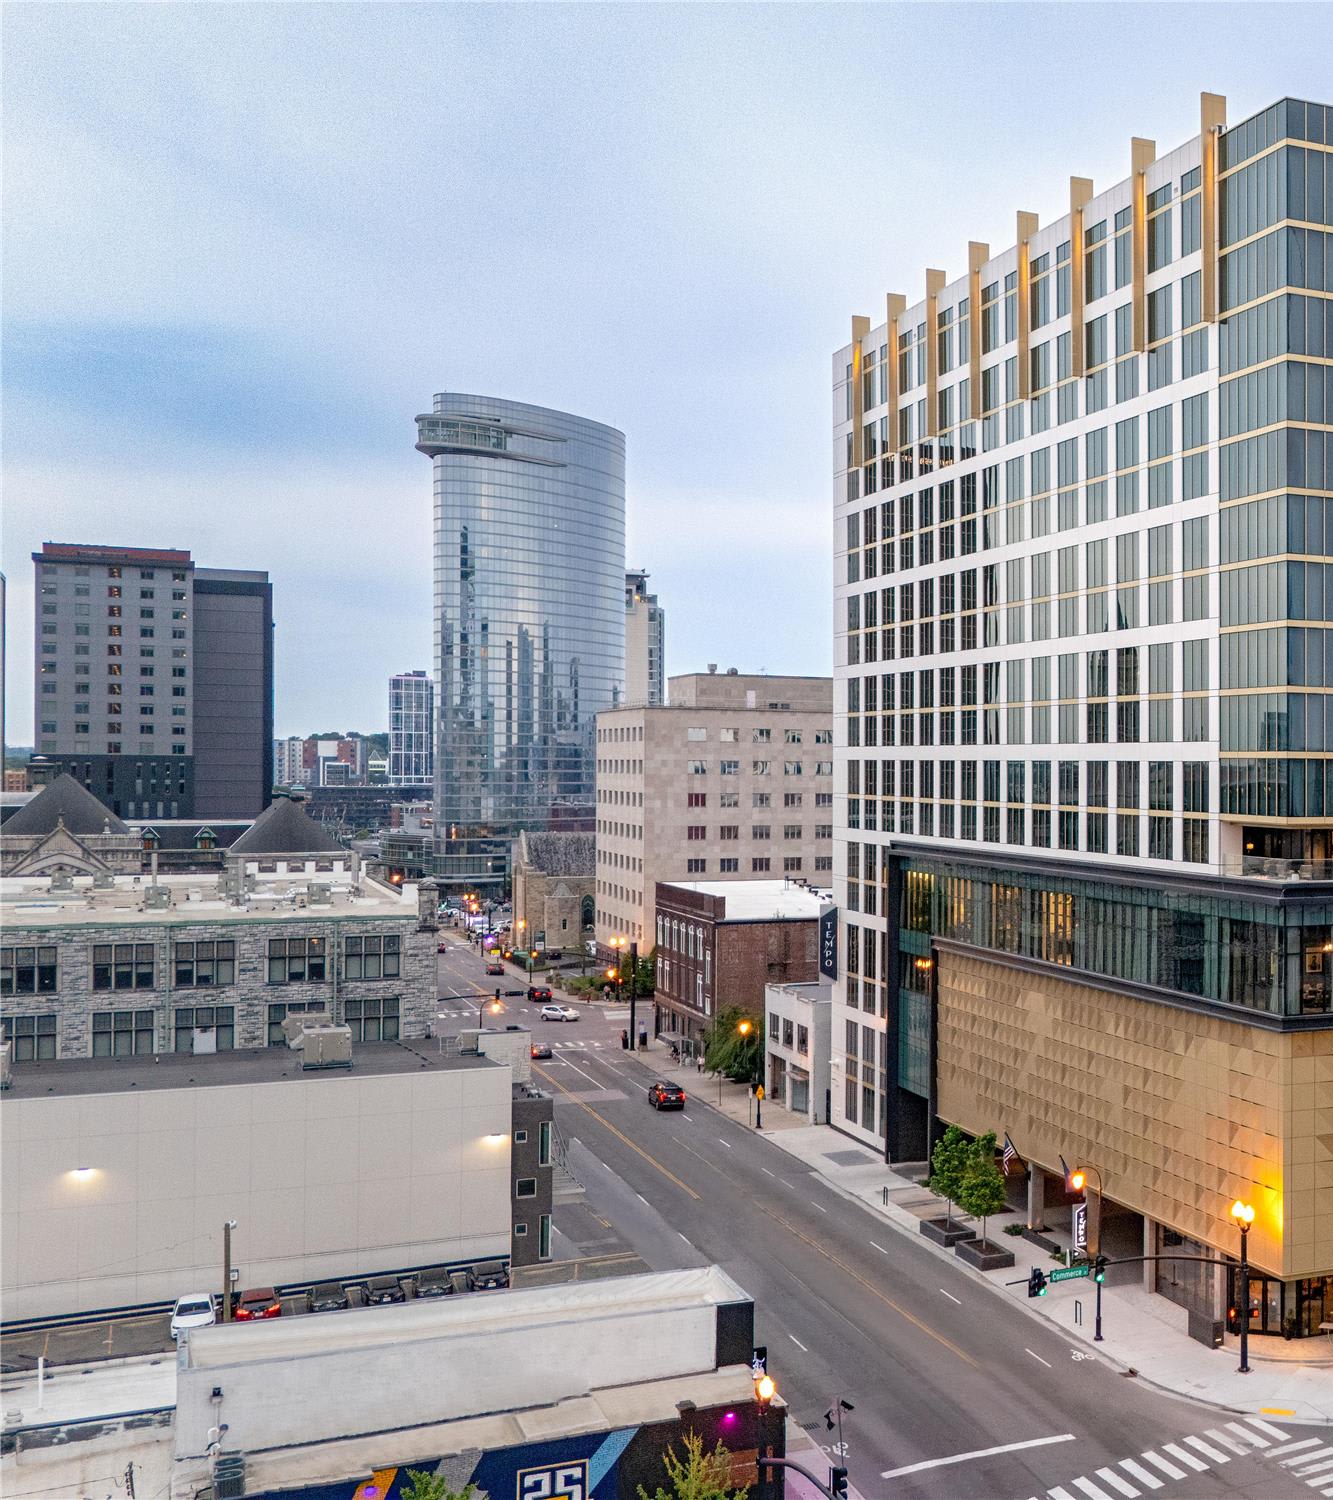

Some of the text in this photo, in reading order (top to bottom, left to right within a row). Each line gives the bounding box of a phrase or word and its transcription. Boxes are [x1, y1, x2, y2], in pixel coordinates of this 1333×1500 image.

[824, 922, 835, 967] TEMPO
[1078, 1211, 1086, 1242] TEMPO
[1052, 1269, 1082, 1281] Commerce
[524, 1467, 582, 1500] 25
